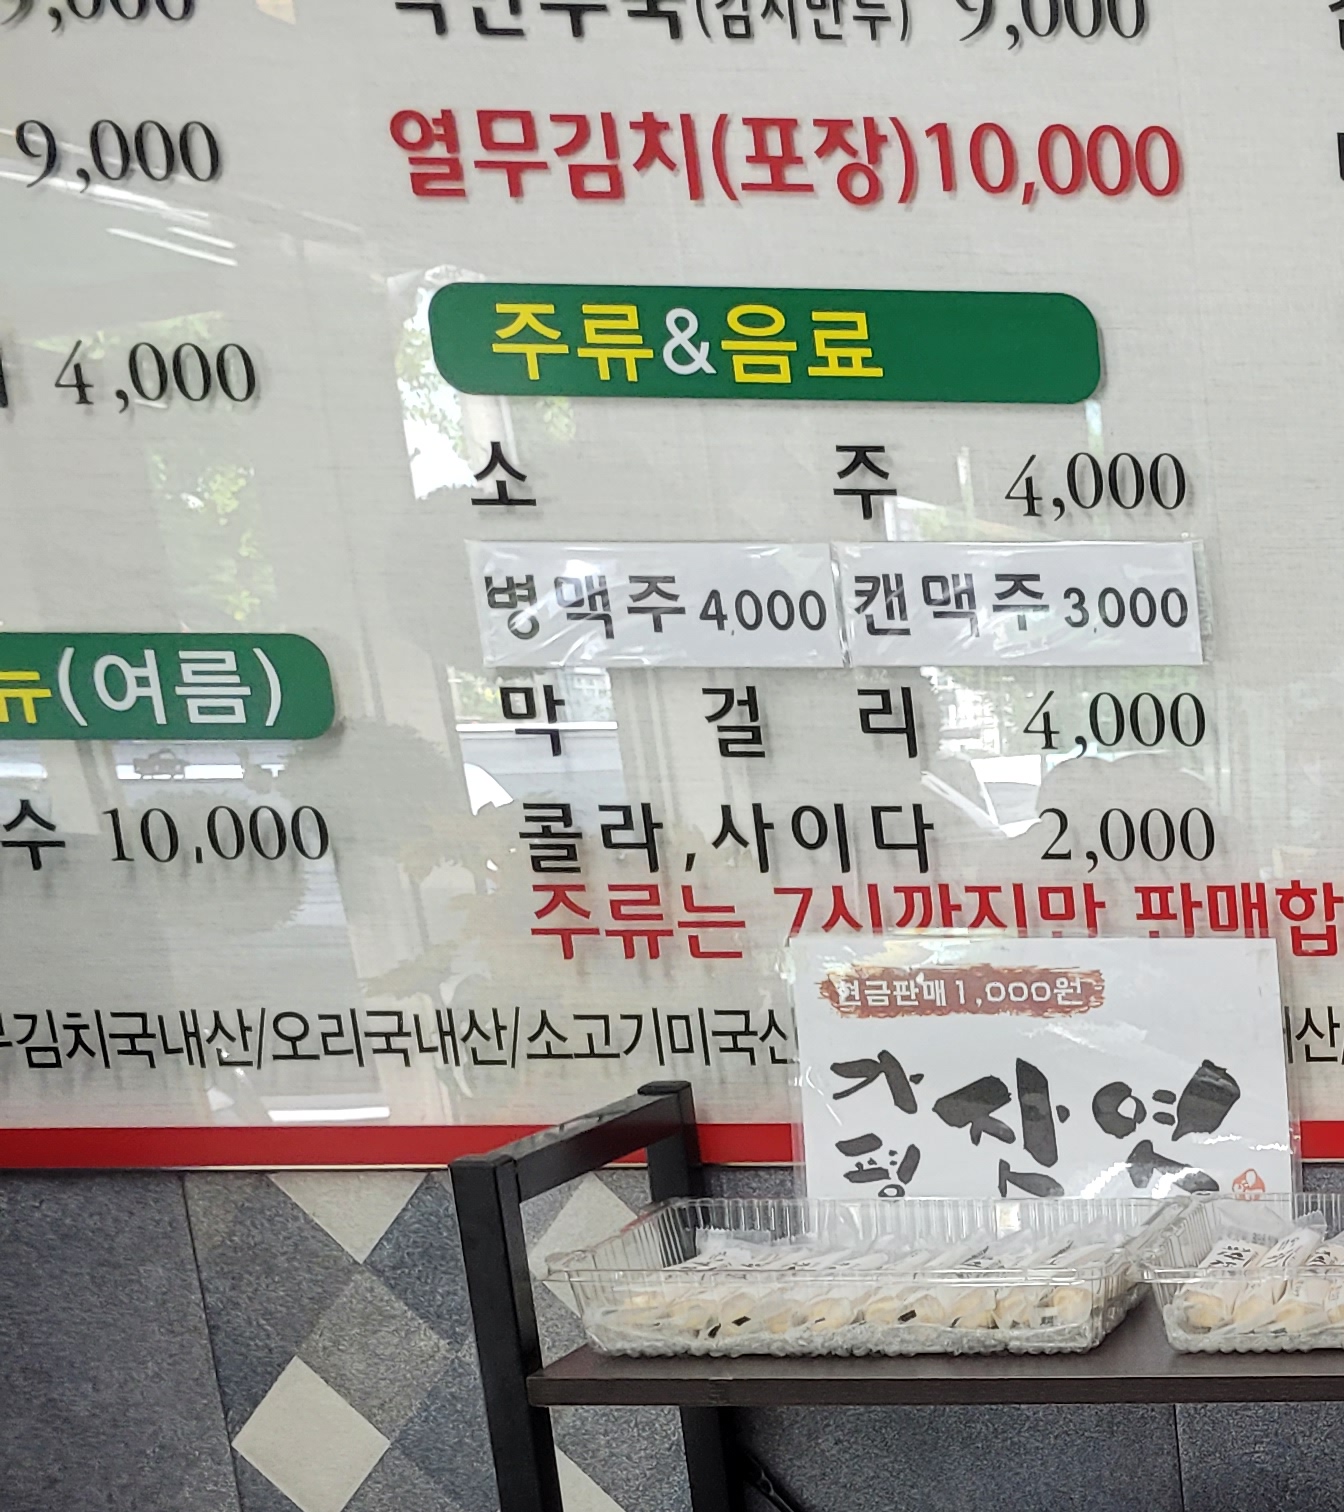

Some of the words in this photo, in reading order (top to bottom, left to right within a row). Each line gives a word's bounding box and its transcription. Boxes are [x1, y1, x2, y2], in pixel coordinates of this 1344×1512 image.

[15, 119, 222, 191] 9,000
[54, 339, 258, 413] 4,000
[491, 301, 885, 385] 주류&음료
[1003, 451, 1188, 522] 4,000
[484, 573, 687, 641] 병맥주
[853, 571, 1050, 639] 캔맥주
[1022, 689, 1207, 758] 4,000
[102, 805, 330, 864] 10,000
[1039, 806, 1216, 870] 2,000
[530, 882, 747, 962] 주류는
